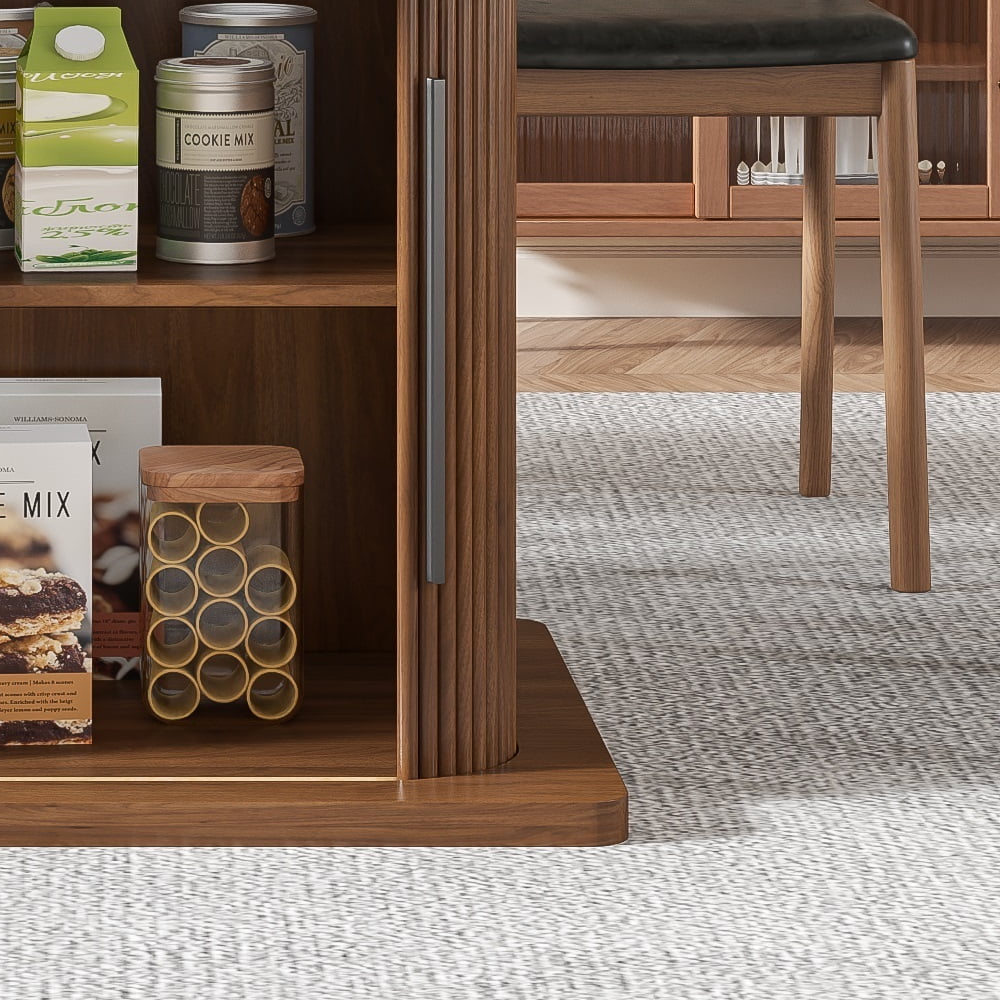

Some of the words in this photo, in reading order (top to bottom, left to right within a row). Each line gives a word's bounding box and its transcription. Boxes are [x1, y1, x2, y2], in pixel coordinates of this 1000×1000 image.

[184, 133, 231, 146] COOKIE
[234, 132, 254, 146] MIX
[23, 491, 70, 519] MIX
